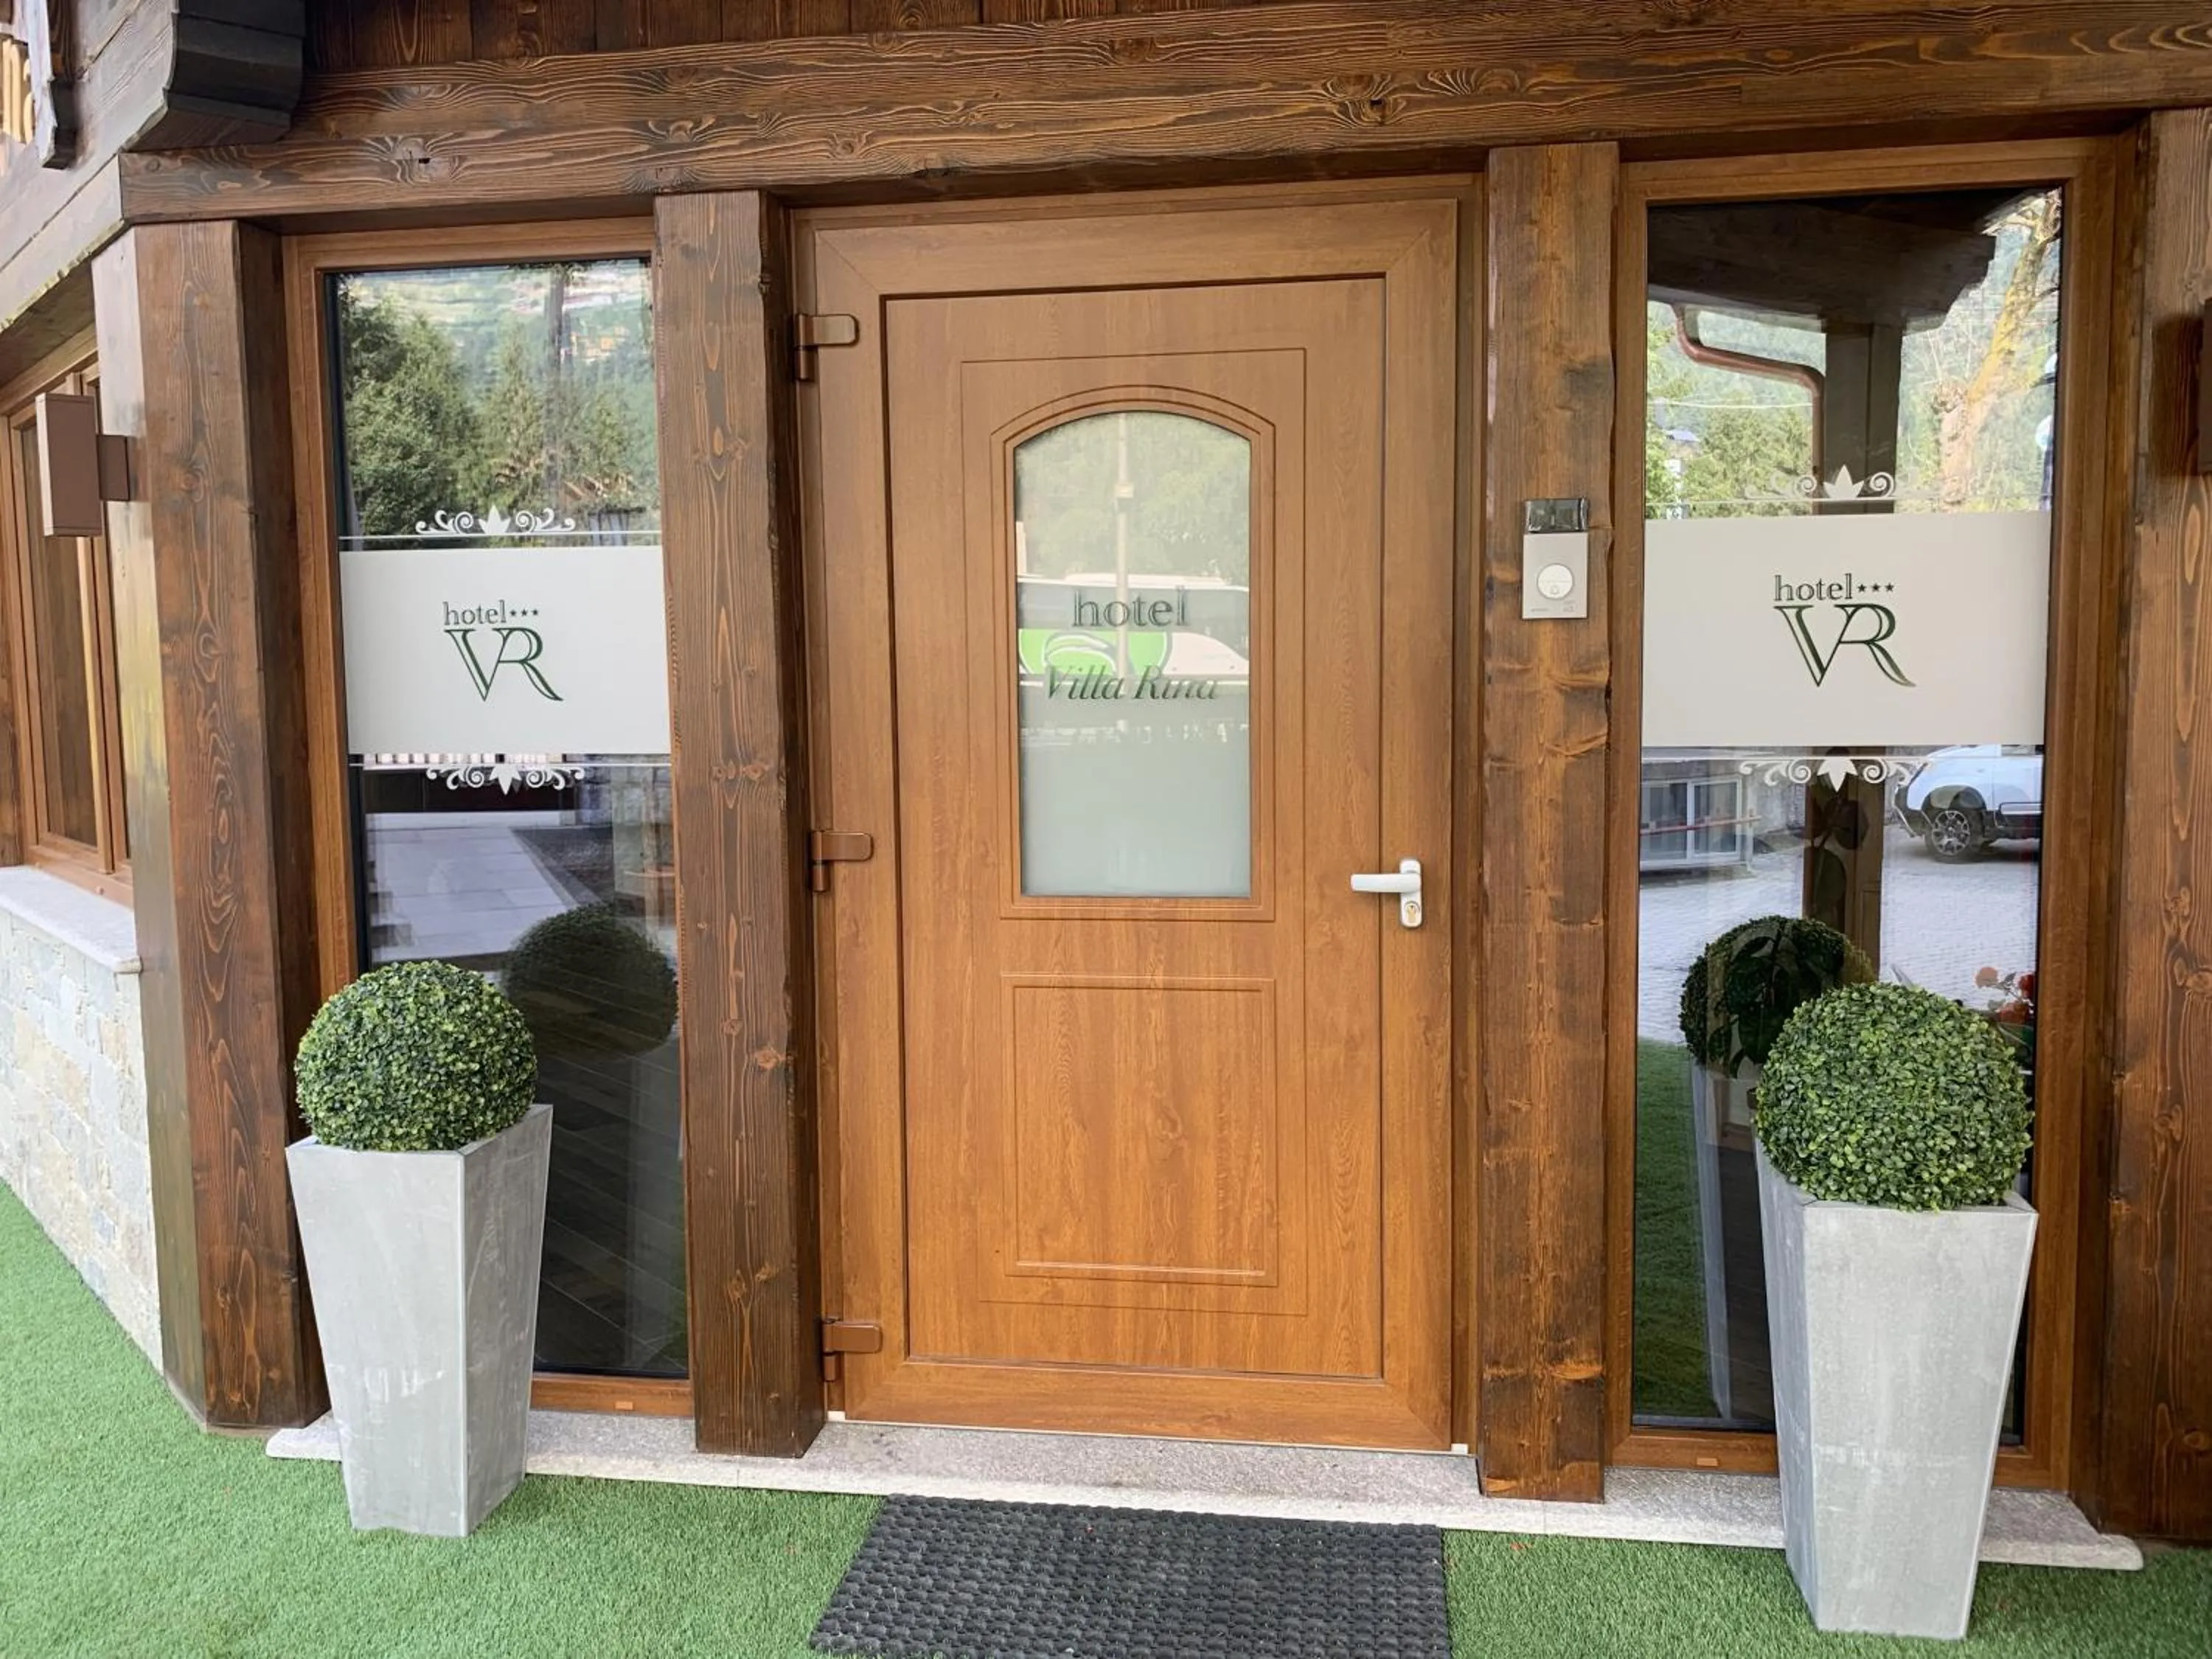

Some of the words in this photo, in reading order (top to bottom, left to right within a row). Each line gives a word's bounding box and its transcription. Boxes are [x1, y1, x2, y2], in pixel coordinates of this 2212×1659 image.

[1072, 585, 1189, 627] hotel
[1773, 573, 1853, 601] hotel
[442, 599, 507, 626] hotel
[444, 627, 564, 702] VR
[1773, 603, 1917, 687] VR
[1045, 664, 1127, 700] Villa
[1132, 664, 1218, 700] Rina
